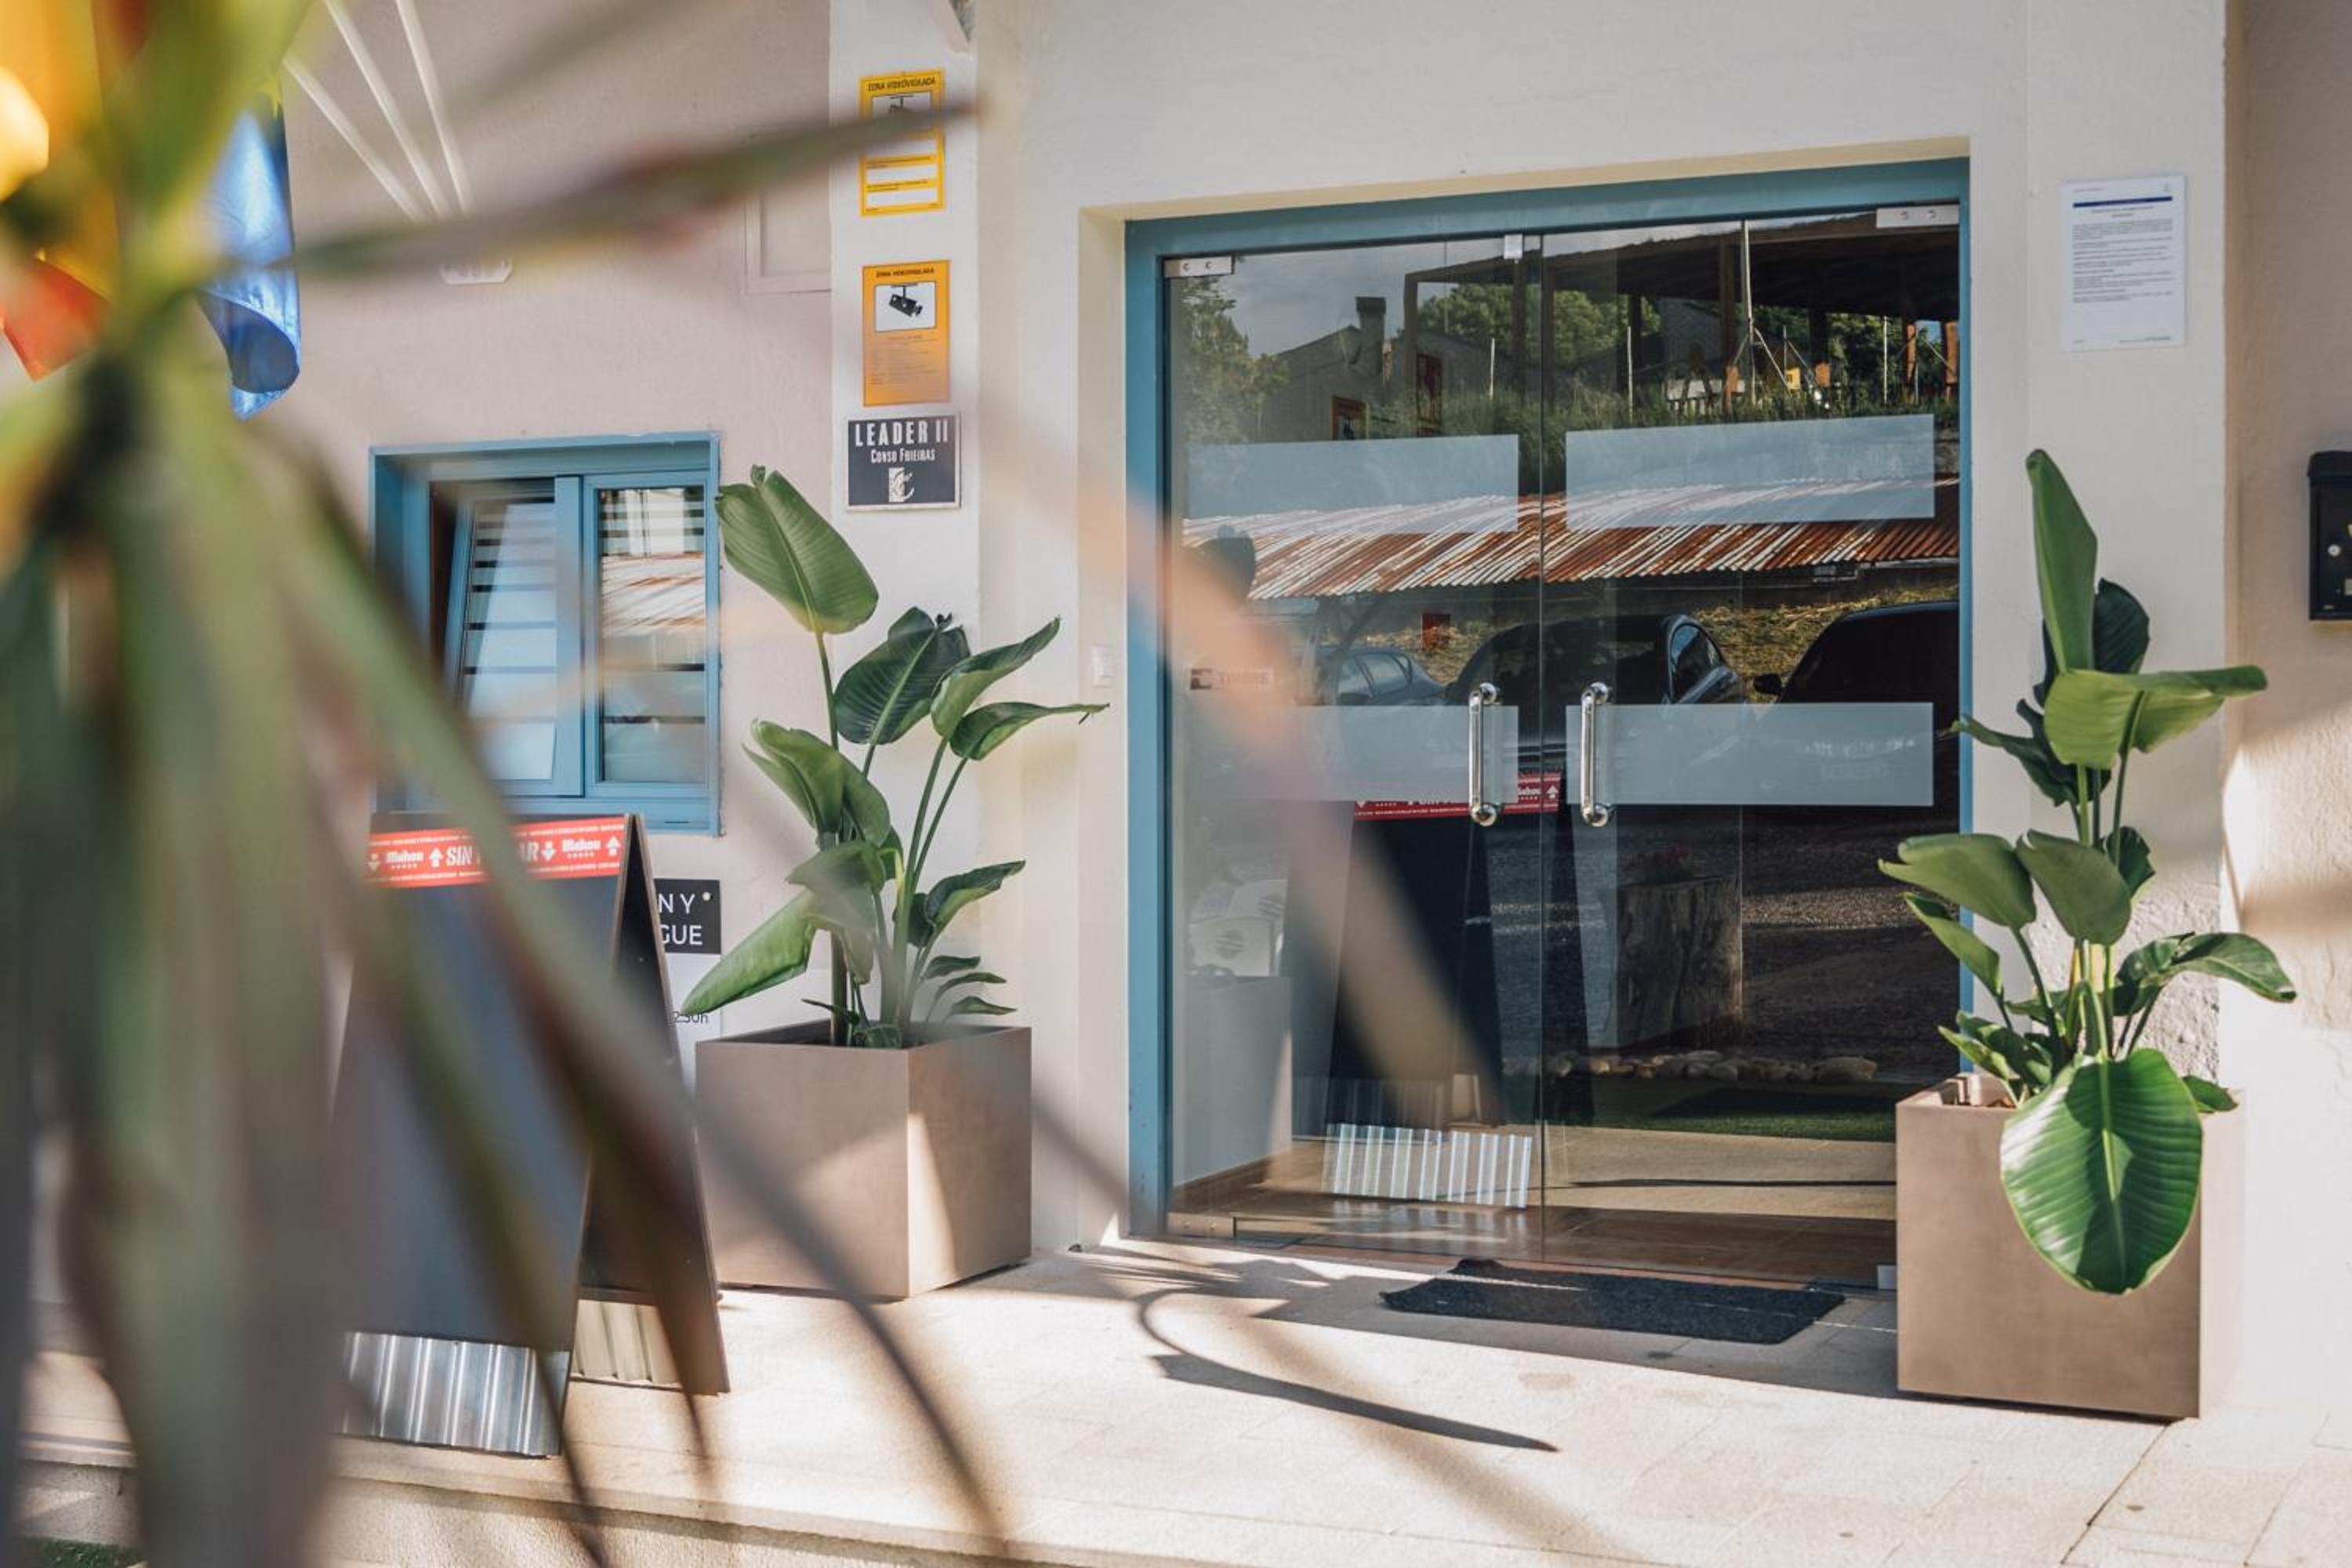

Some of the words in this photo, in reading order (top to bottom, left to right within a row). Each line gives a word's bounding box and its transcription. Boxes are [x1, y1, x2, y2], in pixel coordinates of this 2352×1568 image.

[855, 419, 928, 447] LEADER
[935, 419, 949, 443] II
[445, 846, 473, 866] SIN
